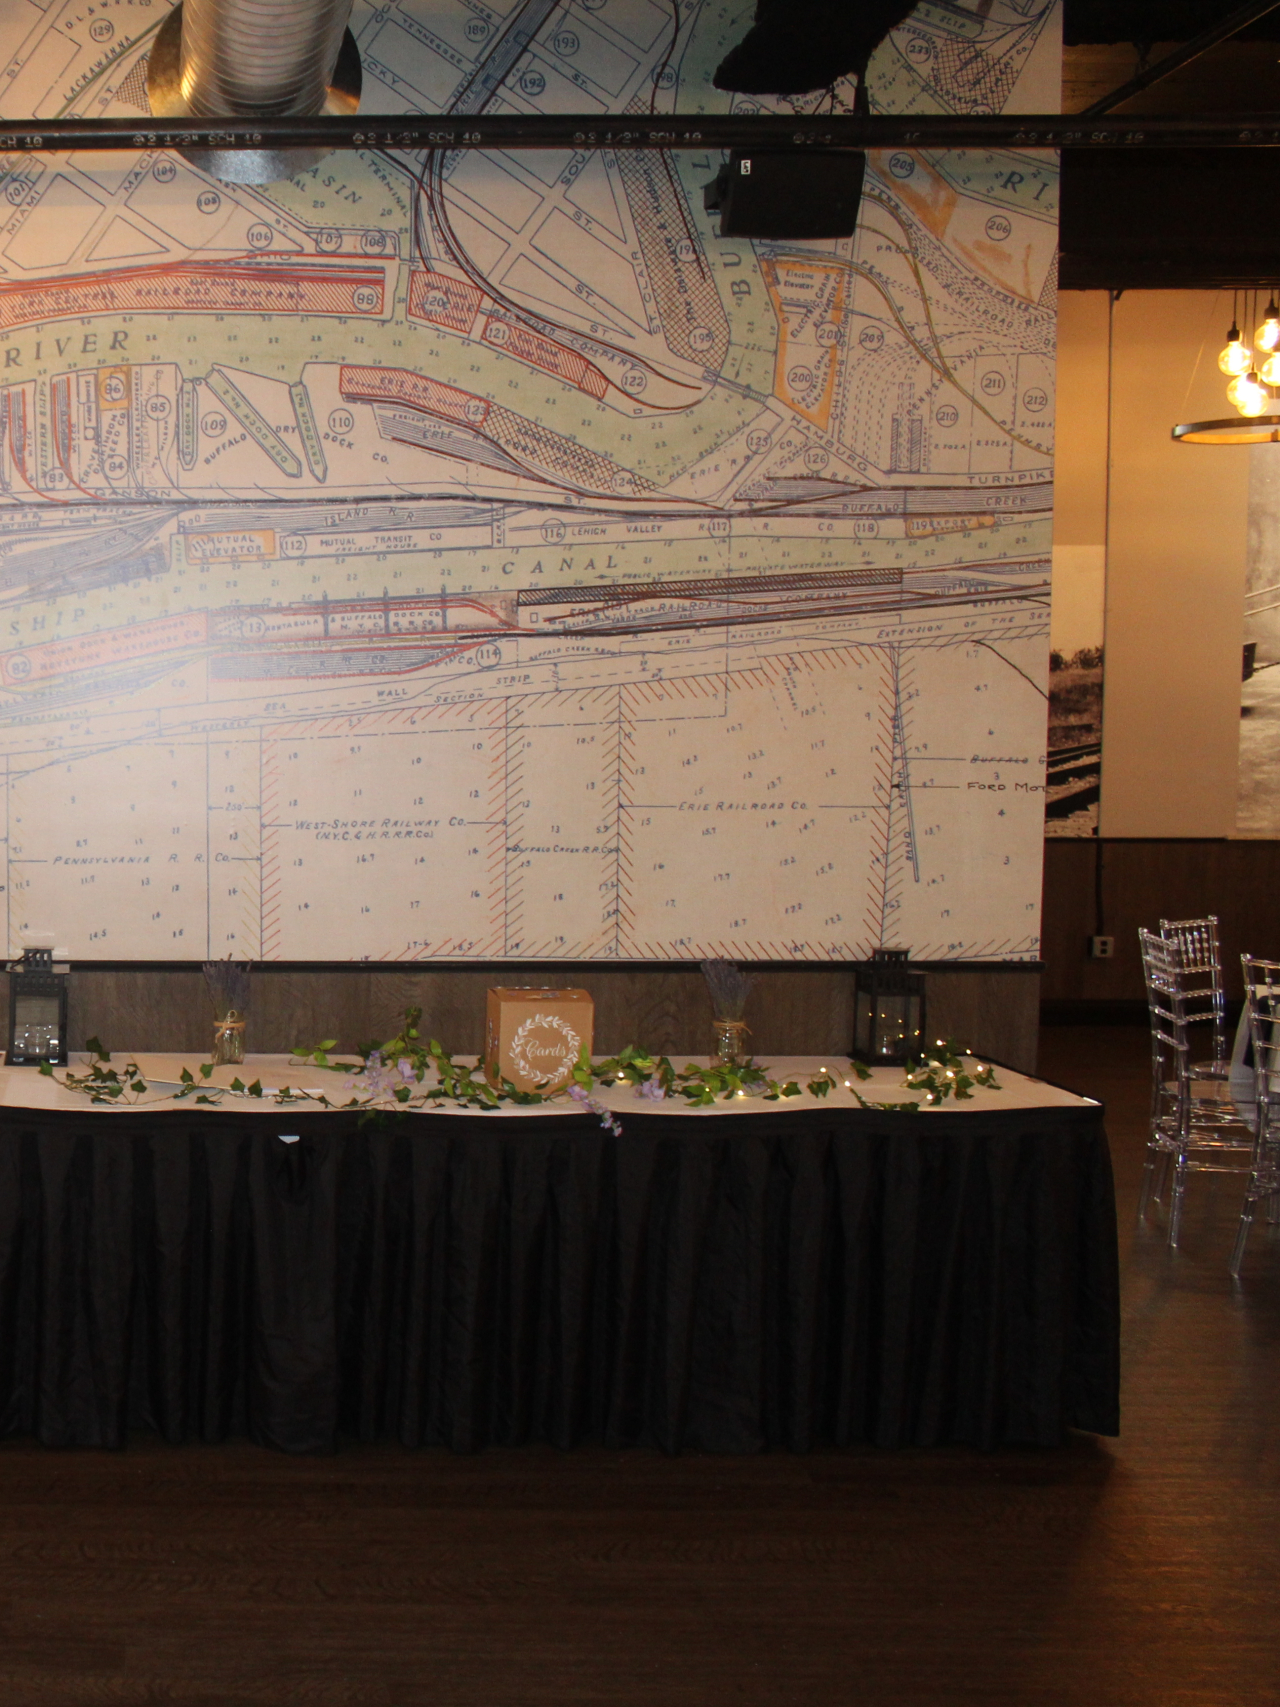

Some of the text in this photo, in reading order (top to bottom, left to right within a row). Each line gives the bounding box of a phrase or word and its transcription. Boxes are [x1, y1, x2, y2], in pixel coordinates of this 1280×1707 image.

[93, 25, 112, 37] 129
[467, 25, 486, 36] 189
[401, 17, 464, 65] TENNESSEE
[555, 37, 576, 50] 193
[63, 34, 134, 101] LACKAWANNA
[522, 76, 543, 90] 192
[156, 164, 175, 177] 104
[891, 158, 913, 172] 205
[6, 189, 42, 235] MIAMI
[988, 221, 1009, 235] 206
[250, 230, 271, 243] 106
[320, 231, 339, 246] 107
[364, 236, 384, 248] 108
[356, 292, 374, 305] 88
[486, 326, 507, 340] 121
[692, 331, 711, 346] 195
[861, 332, 882, 345] 209
[3, 329, 130, 368] RIVER
[623, 374, 644, 387] 122
[790, 371, 811, 385] 200
[984, 377, 1004, 390] 211
[1026, 393, 1046, 407] 212
[149, 402, 167, 414] 85
[466, 403, 486, 416] 123
[330, 415, 351, 429] 110
[938, 410, 958, 422] 210
[203, 418, 224, 432] 109
[323, 431, 355, 450] DOCK
[750, 434, 770, 447] 125
[790, 413, 869, 473] HAMBURG
[203, 432, 248, 466] BUFFALO
[806, 453, 827, 466] 126
[612, 476, 634, 488] 124
[94, 488, 171, 499] GANSON
[323, 508, 369, 526] ISLAND
[543, 525, 564, 537] 116
[570, 524, 663, 536] LEHIGH VALLEY
[710, 522, 729, 533] 117
[856, 522, 876, 535] 118
[282, 539, 302, 551] 112
[320, 535, 414, 547] MUTUAL TRANSIT
[201, 545, 263, 556] ELEVATOR
[501, 555, 619, 576] CANAL
[9, 609, 86, 635] SHIP
[877, 616, 1016, 640] EXTENSION OF THE
[479, 648, 499, 660] 114
[376, 674, 531, 697] WALL STRIP
[434, 692, 485, 704] SECTION
[967, 782, 1007, 793] FORD
[678, 801, 713, 811] ERIE
[716, 801, 785, 811] RAILROAD
[295, 819, 376, 831] WEST-SHORE
[381, 817, 440, 828] RAILWAY
[52, 856, 151, 866] PENNSYLVANIA
[522, 1037, 567, 1061] Cards
